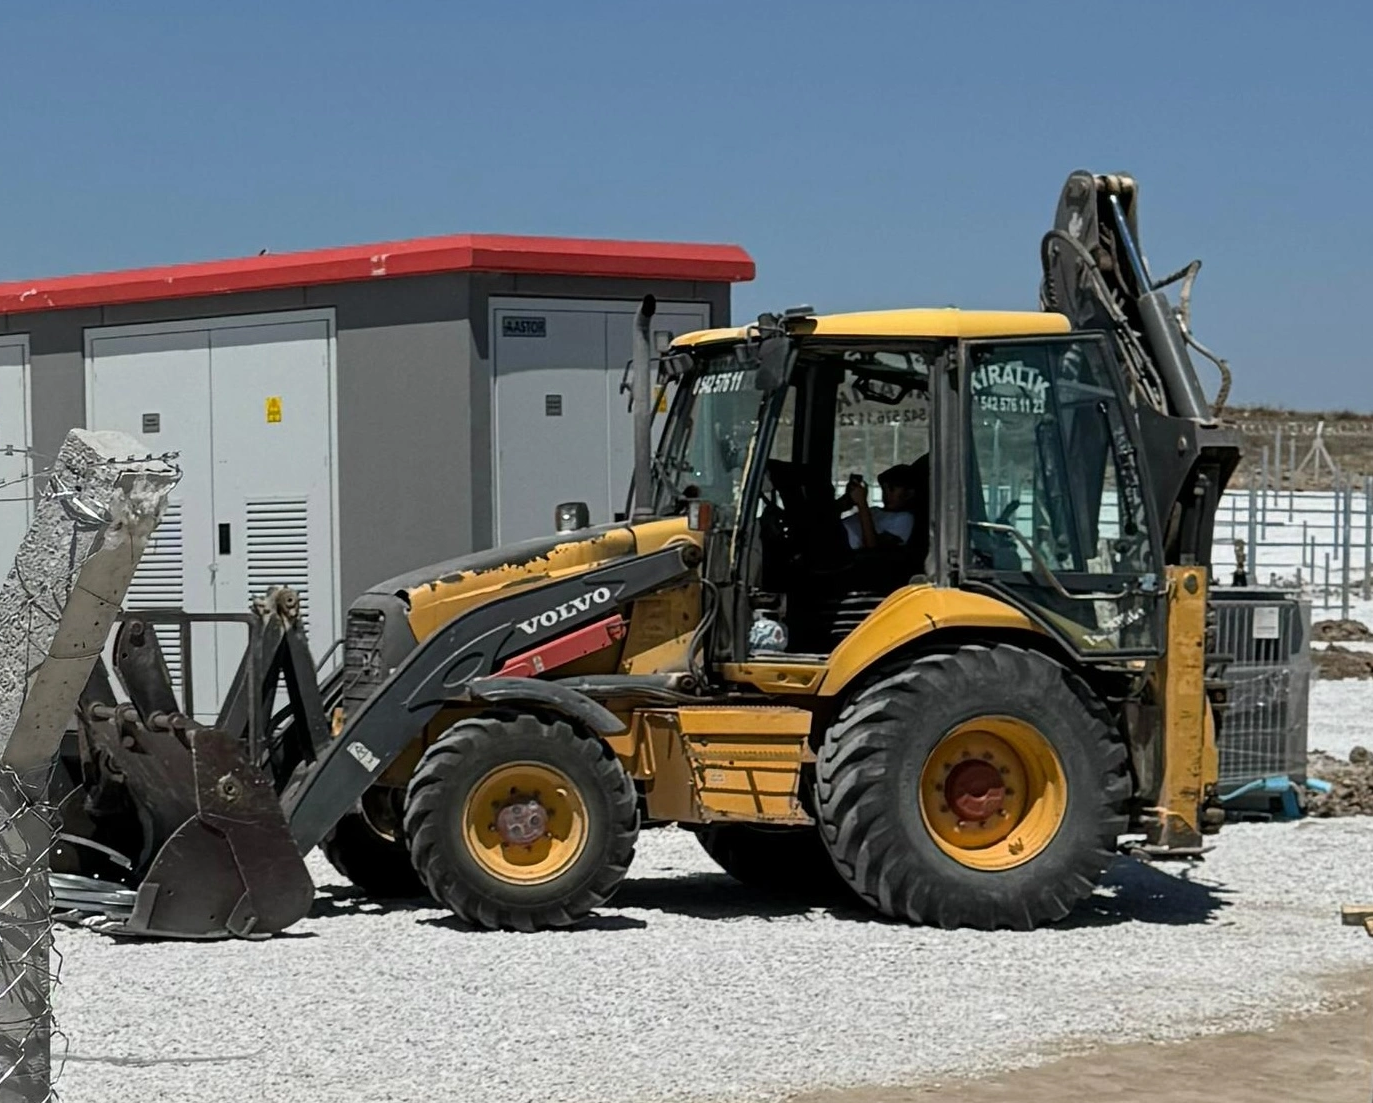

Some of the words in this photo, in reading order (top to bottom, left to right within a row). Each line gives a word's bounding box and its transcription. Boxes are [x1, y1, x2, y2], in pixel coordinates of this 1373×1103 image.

[730, 371, 746, 391] 11
[980, 396, 998, 411] 542
[1000, 397, 1017, 412] 576
[1020, 397, 1030, 413] 11
[1033, 399, 1046, 414] 23
[516, 587, 611, 635] VOLVO
